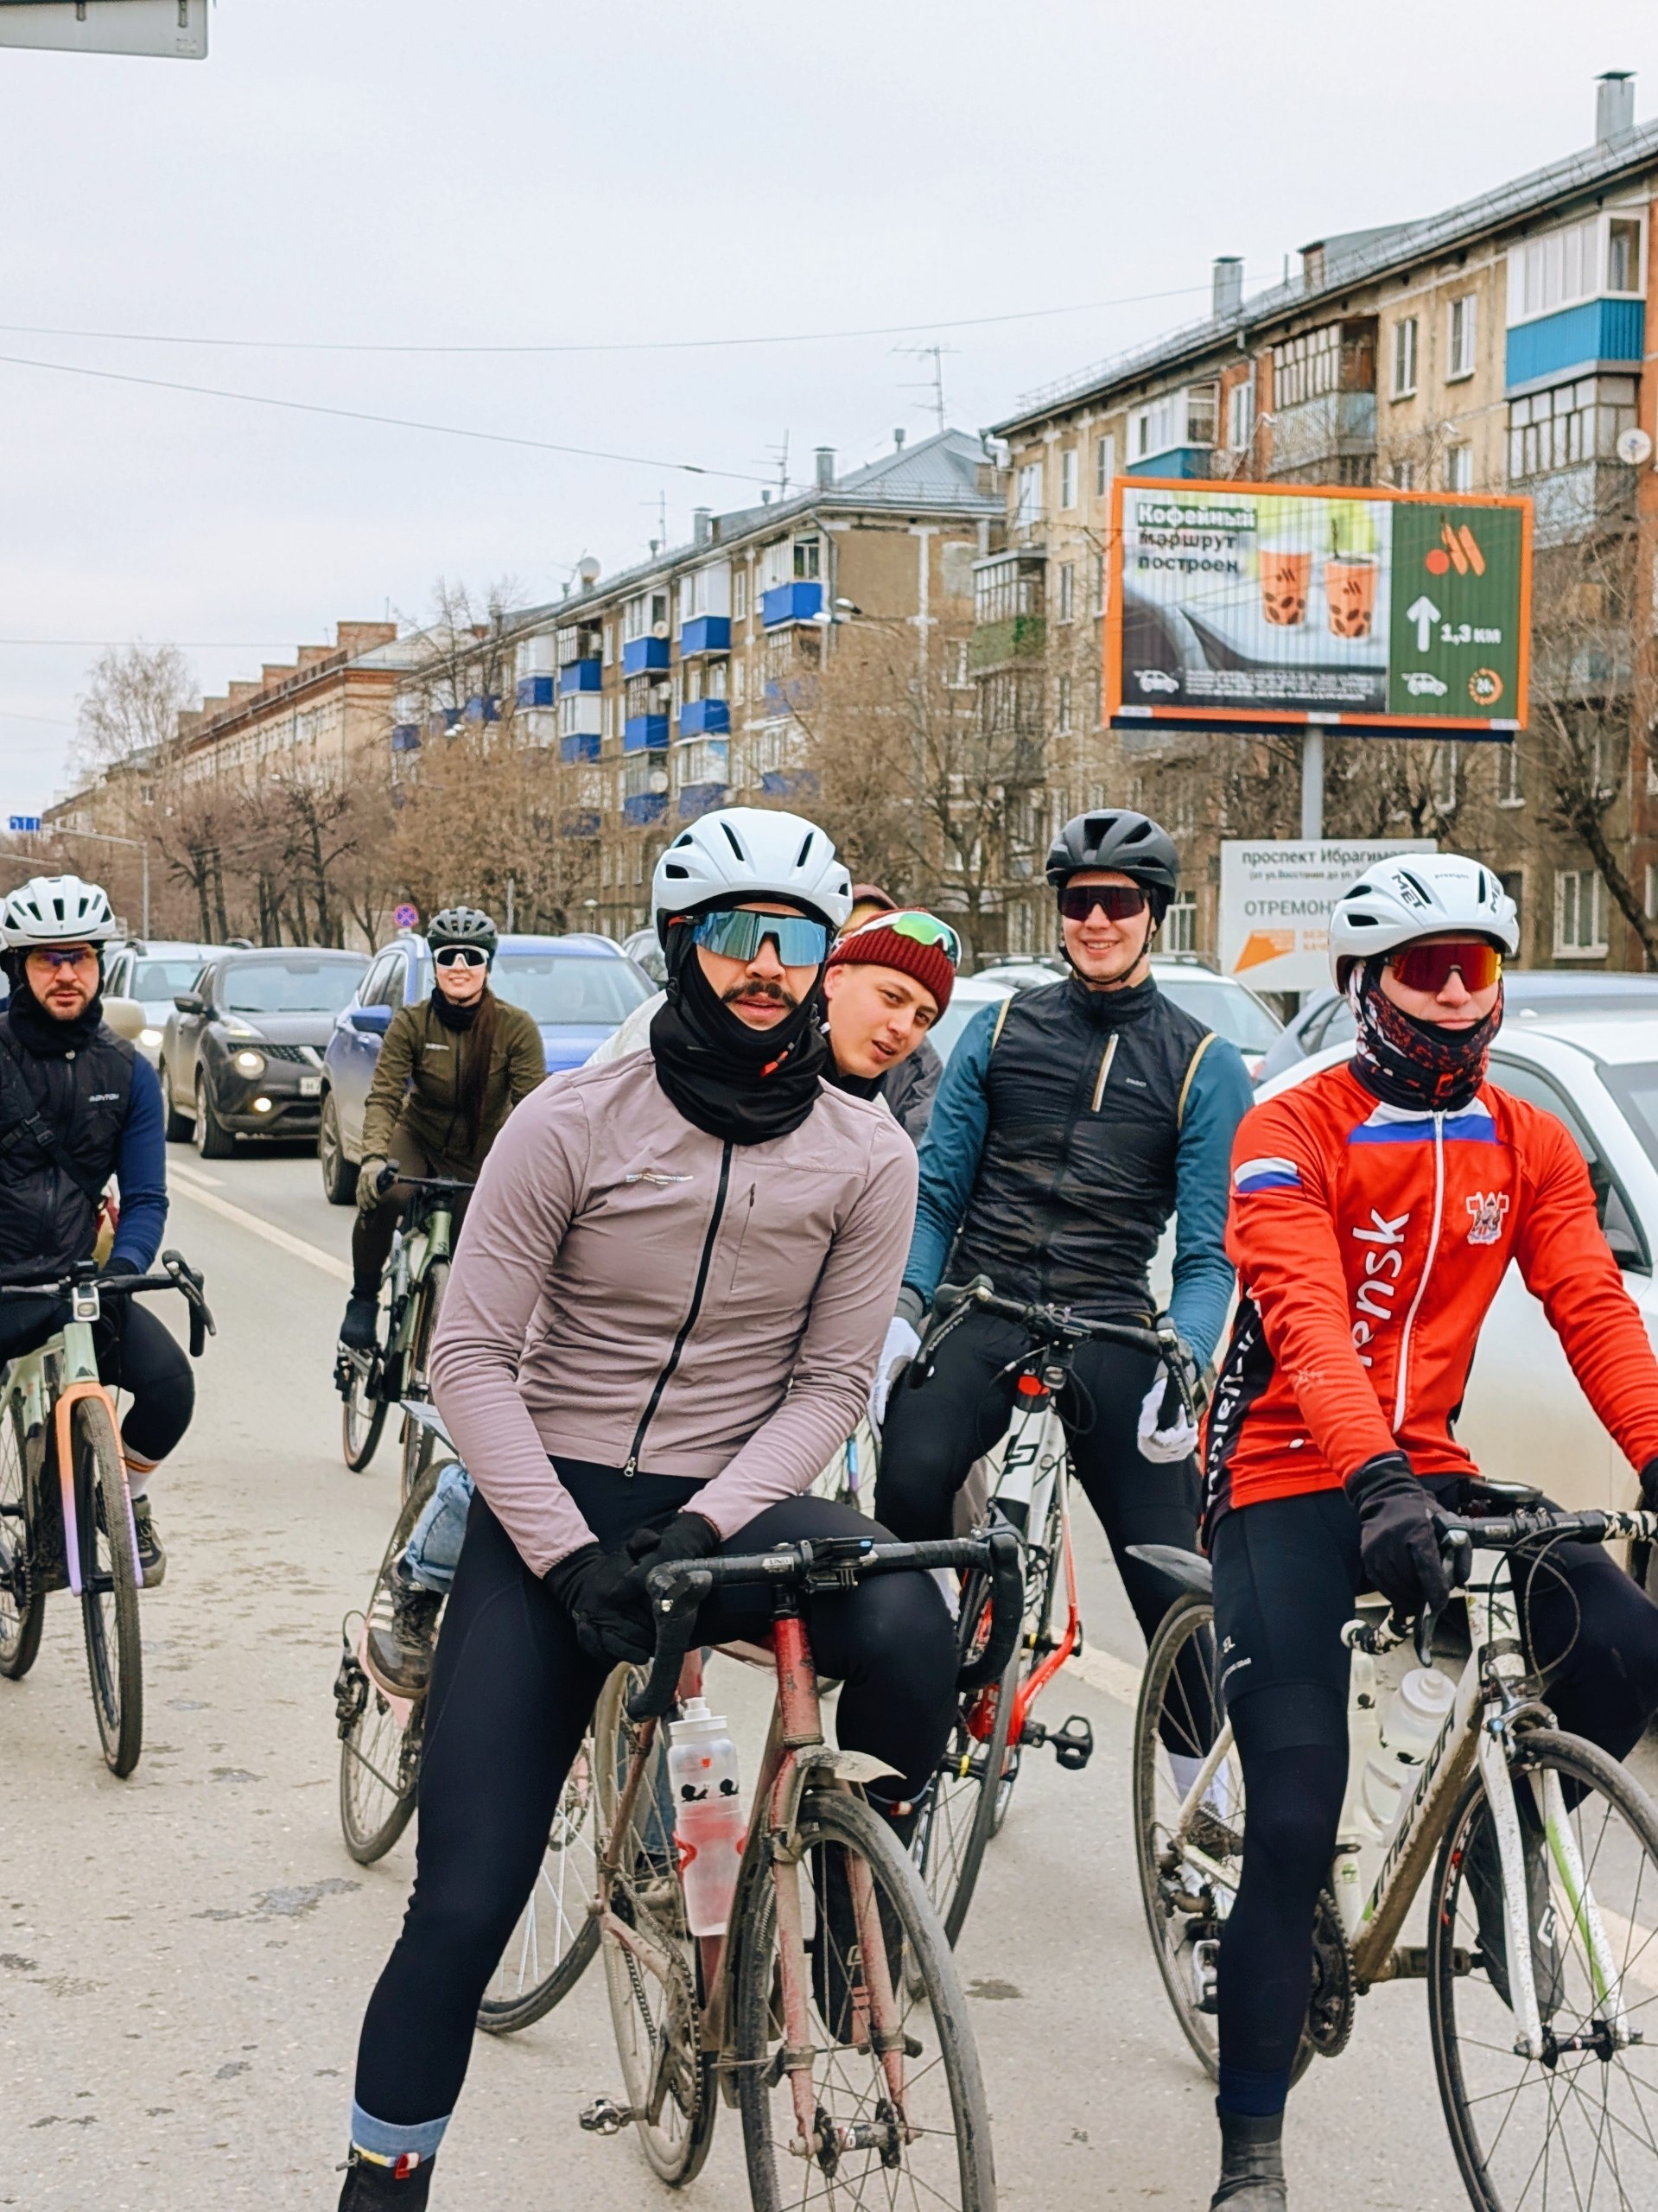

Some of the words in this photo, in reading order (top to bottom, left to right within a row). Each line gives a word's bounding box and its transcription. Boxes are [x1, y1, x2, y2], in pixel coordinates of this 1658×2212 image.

[1139, 504, 1256, 528] Кофейный
[1139, 532, 1237, 552] маршрут
[1139, 556, 1238, 573] построен
[1242, 851, 1315, 868] проспект
[1320, 847, 1417, 867] Ибрагим
[1391, 874, 1427, 910] MET
